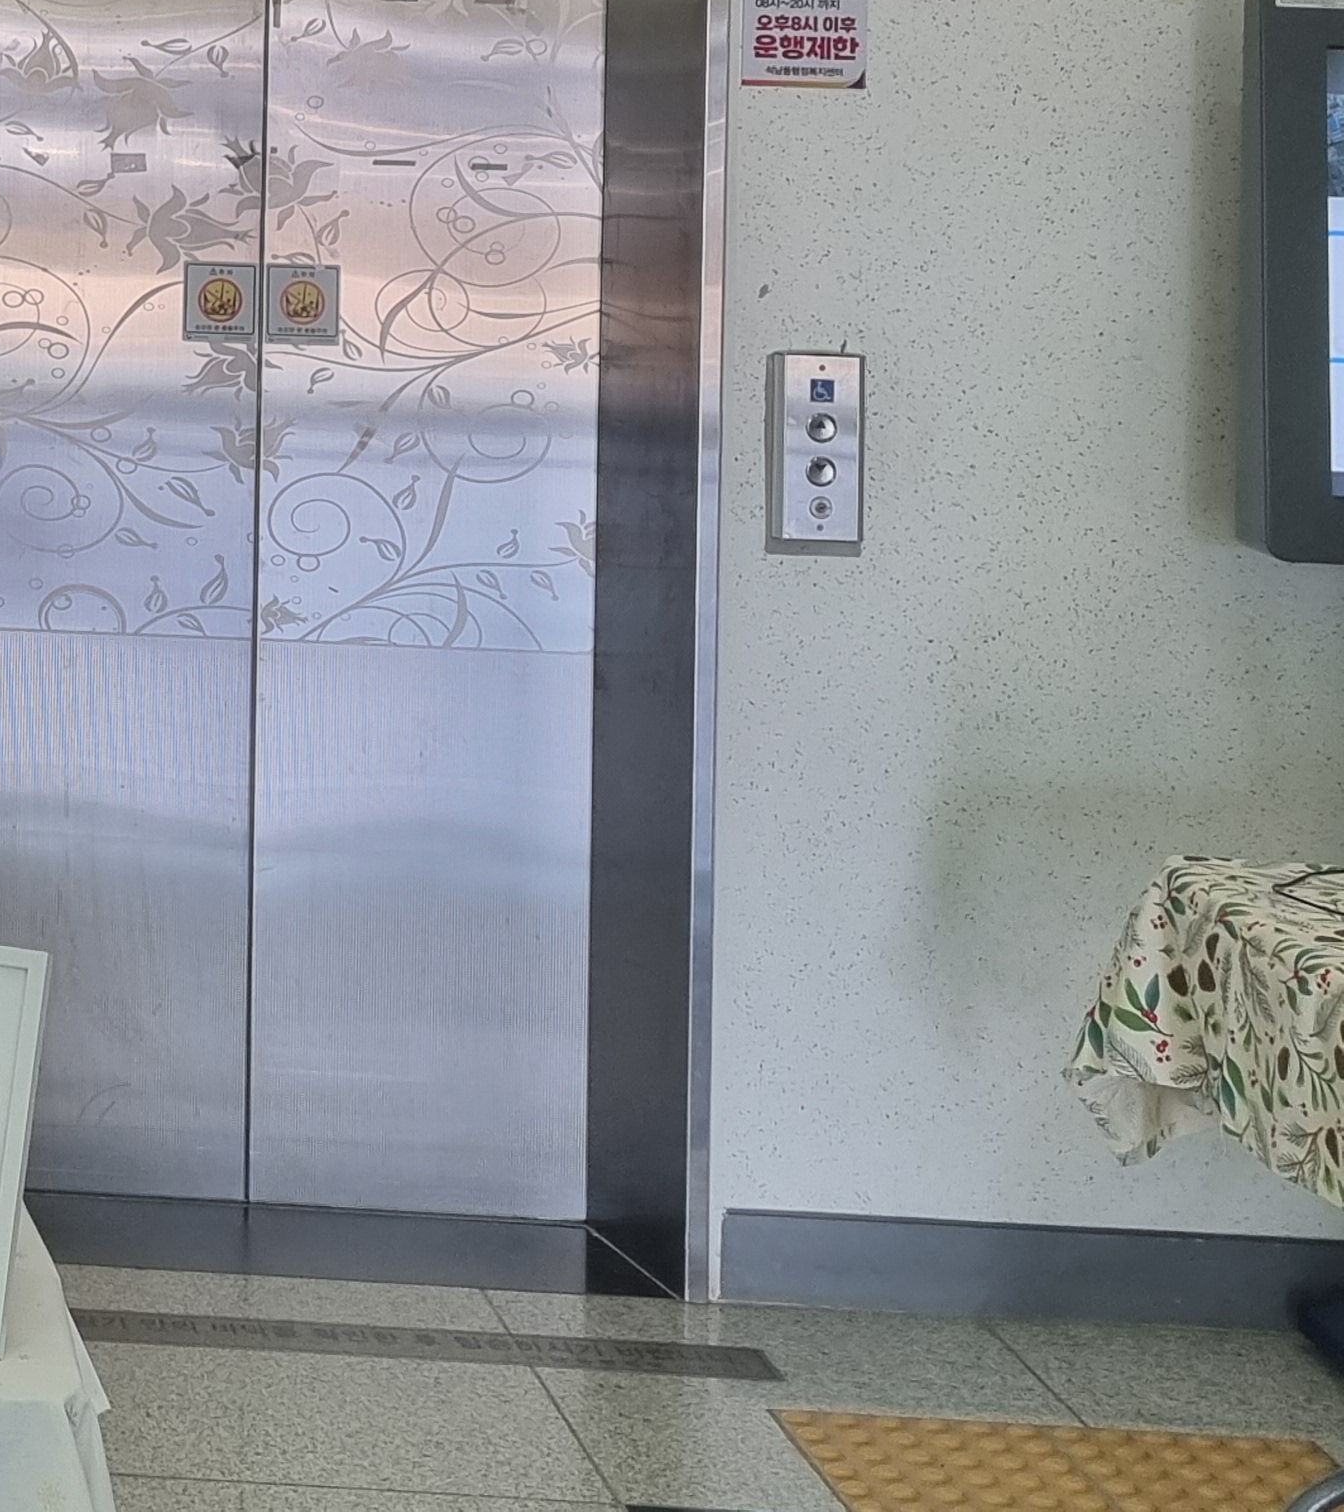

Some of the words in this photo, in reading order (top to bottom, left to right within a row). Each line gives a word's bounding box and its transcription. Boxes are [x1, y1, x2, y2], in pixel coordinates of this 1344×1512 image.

[755, 14, 818, 33] 오후8시
[823, 16, 857, 33] 이후
[753, 34, 860, 61] 운행제한
